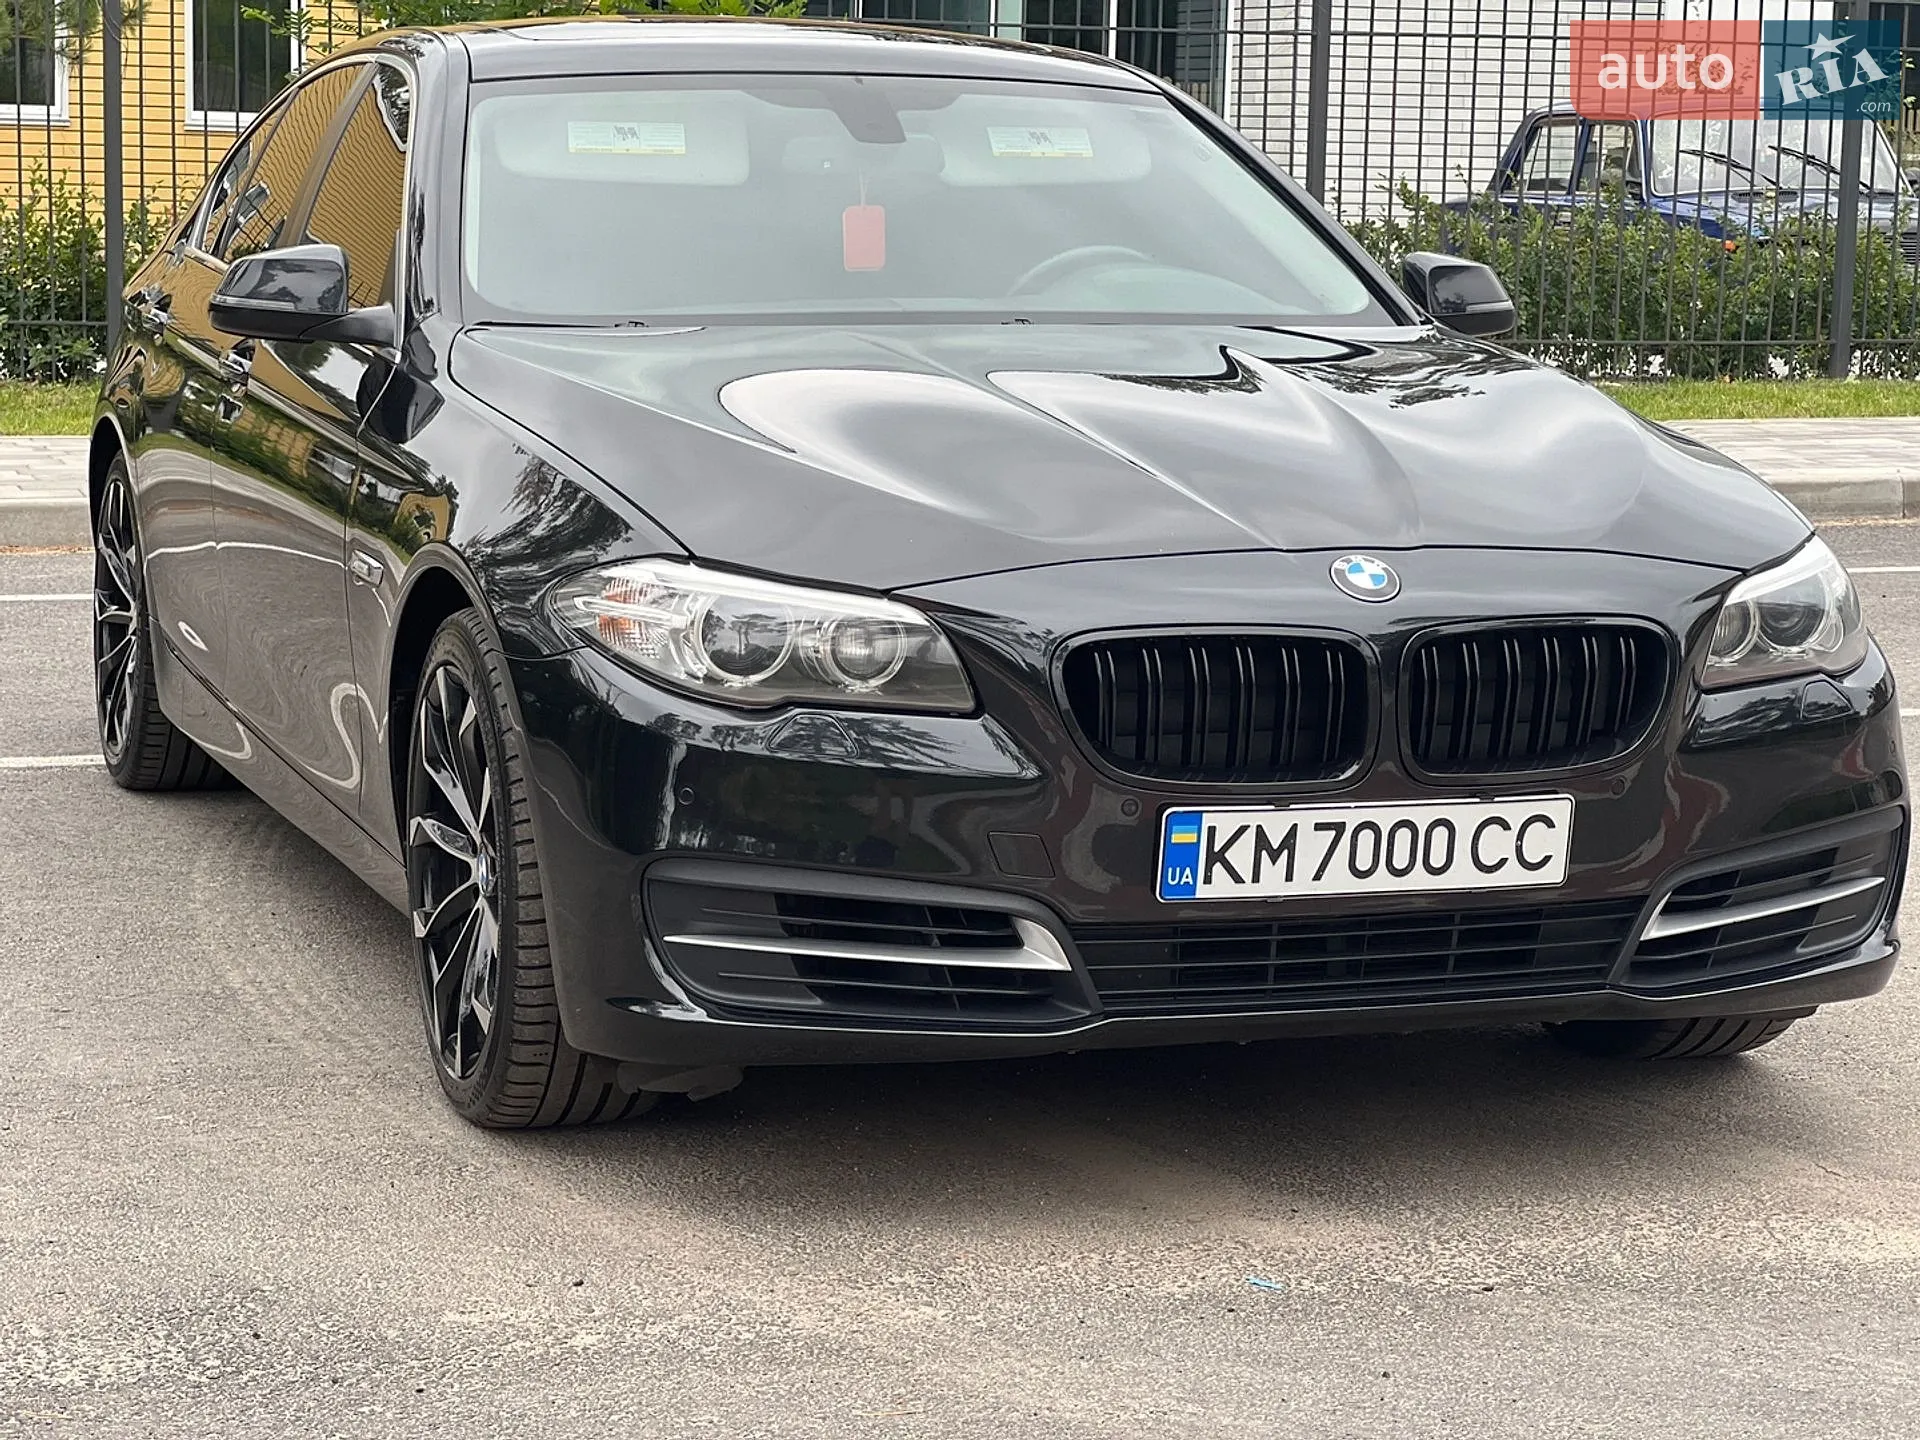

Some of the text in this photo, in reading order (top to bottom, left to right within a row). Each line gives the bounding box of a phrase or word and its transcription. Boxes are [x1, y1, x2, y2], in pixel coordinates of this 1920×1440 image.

[1202, 813, 1556, 885] KM 7000 CC
[1167, 868, 1194, 886] UA
